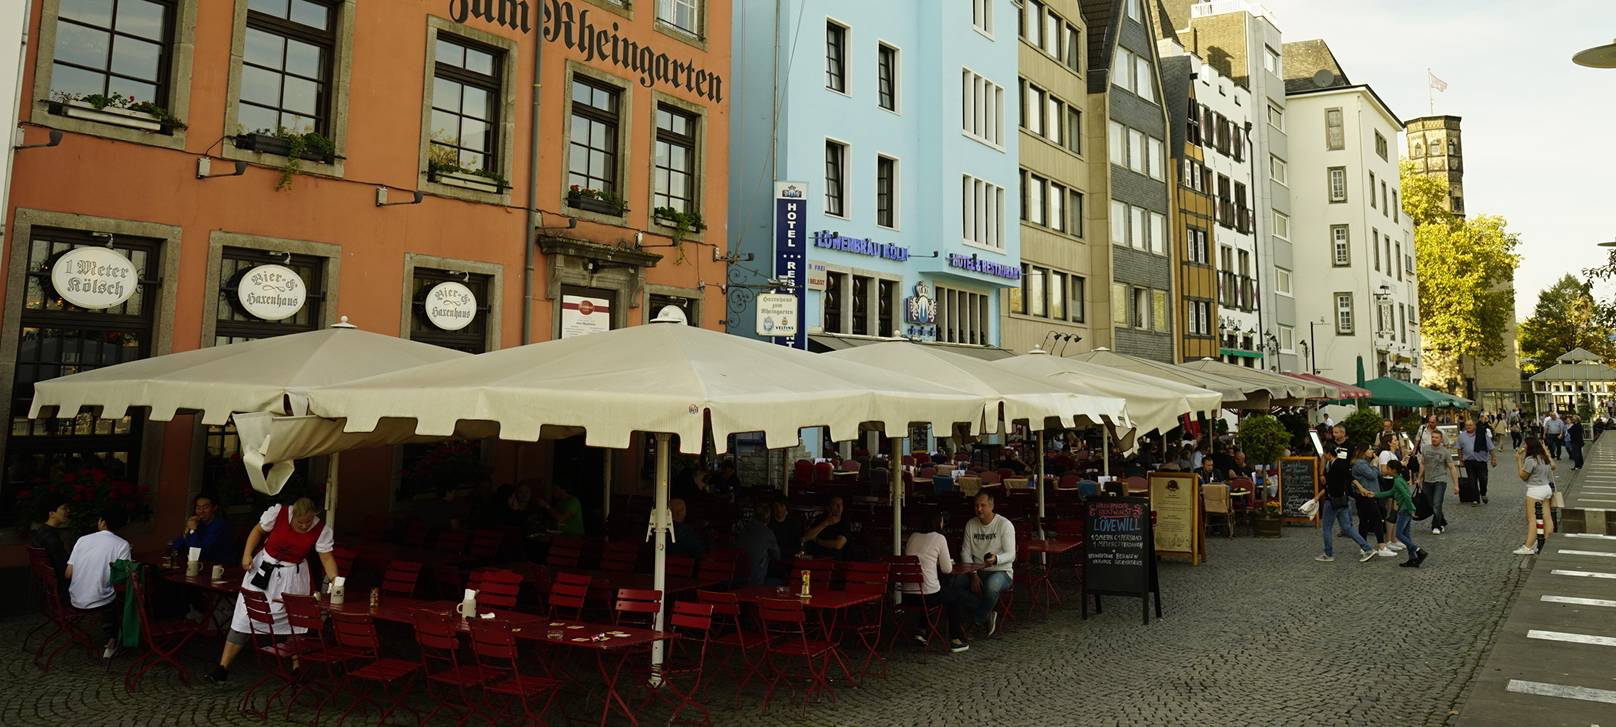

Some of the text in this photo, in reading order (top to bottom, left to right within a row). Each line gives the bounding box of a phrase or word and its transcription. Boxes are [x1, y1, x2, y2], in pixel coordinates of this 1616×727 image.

[543, 1, 723, 104] Rheingarten
[786, 202, 798, 248] HOTEL
[65, 260, 129, 279] 1 Meter
[67, 277, 124, 299] Kölsch
[247, 292, 298, 307] Haxenhaus
